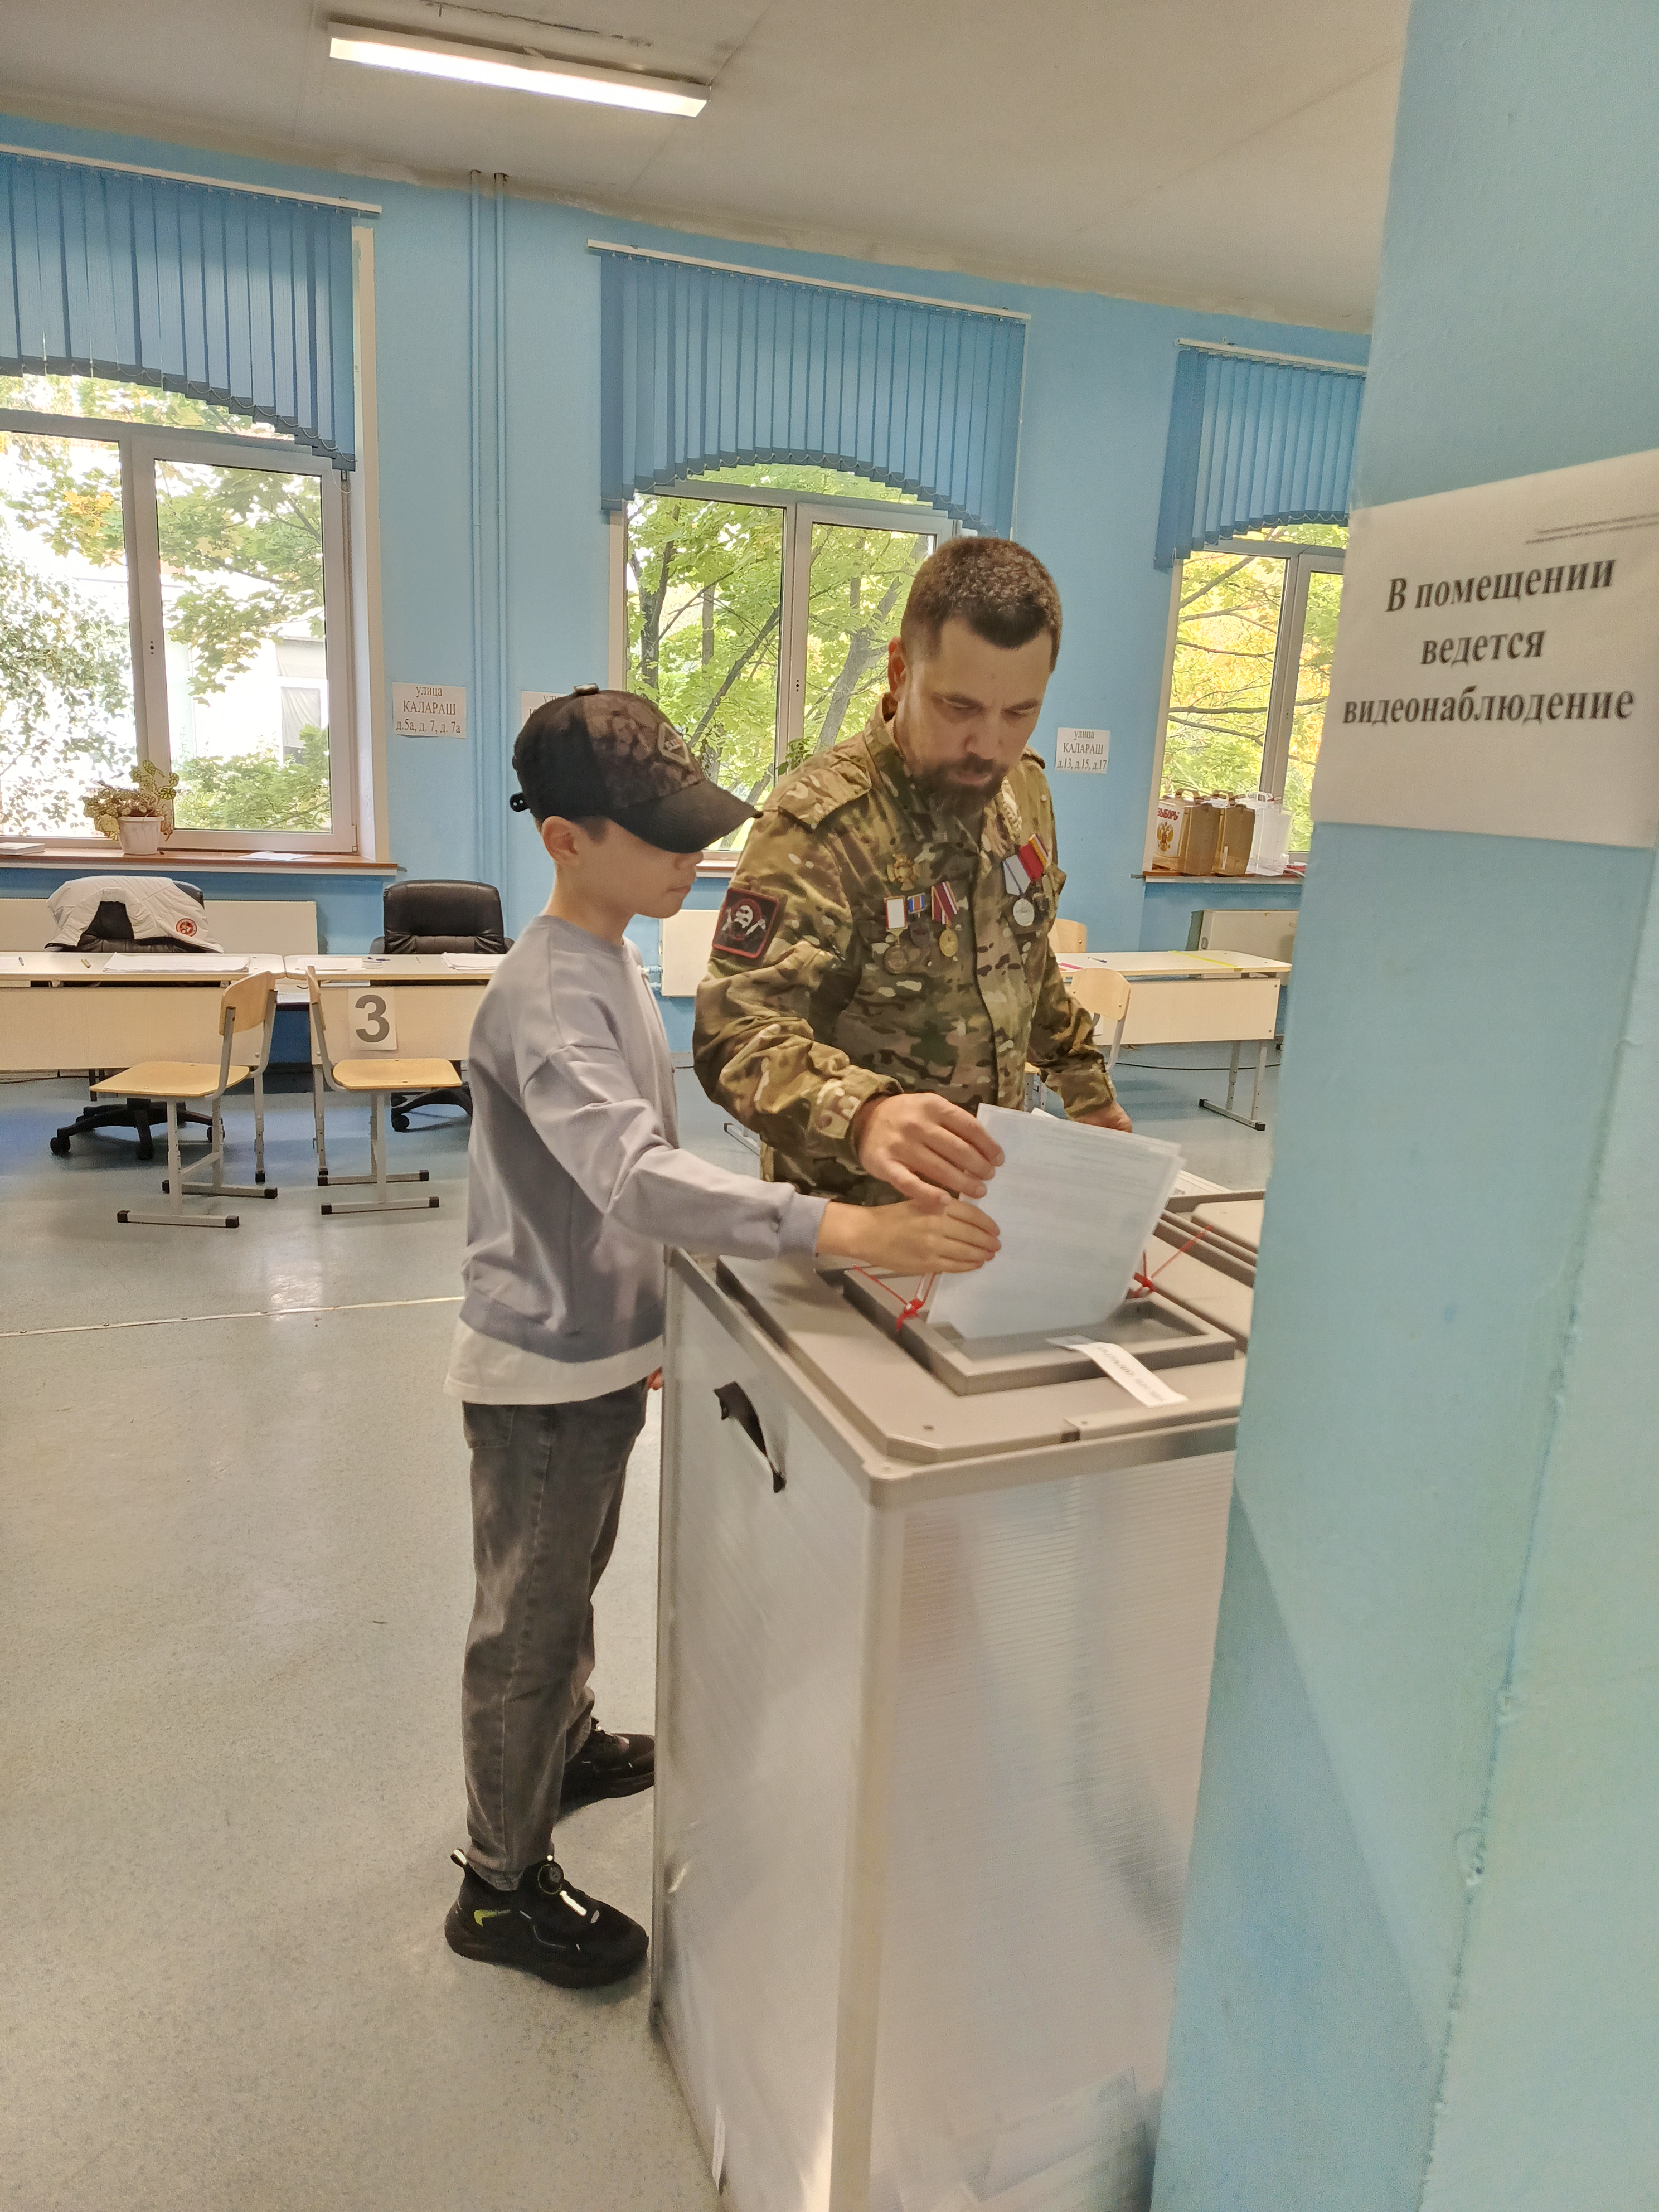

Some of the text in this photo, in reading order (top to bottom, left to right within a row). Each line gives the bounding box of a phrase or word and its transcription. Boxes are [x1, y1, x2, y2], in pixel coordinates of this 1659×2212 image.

[1385, 559, 1616, 613] В помещении
[1420, 629, 1546, 668] ведется
[416, 686, 443, 698] улица
[403, 700, 455, 715] КАЛАРАШ
[1342, 685, 1636, 727] видеонаблюдение
[451, 721, 460, 733] 7а
[1074, 730, 1094, 740] улица
[1063, 743, 1103, 754] КАЛАРАШ
[1092, 760, 1107, 770] д.17
[355, 994, 390, 1043] 3
